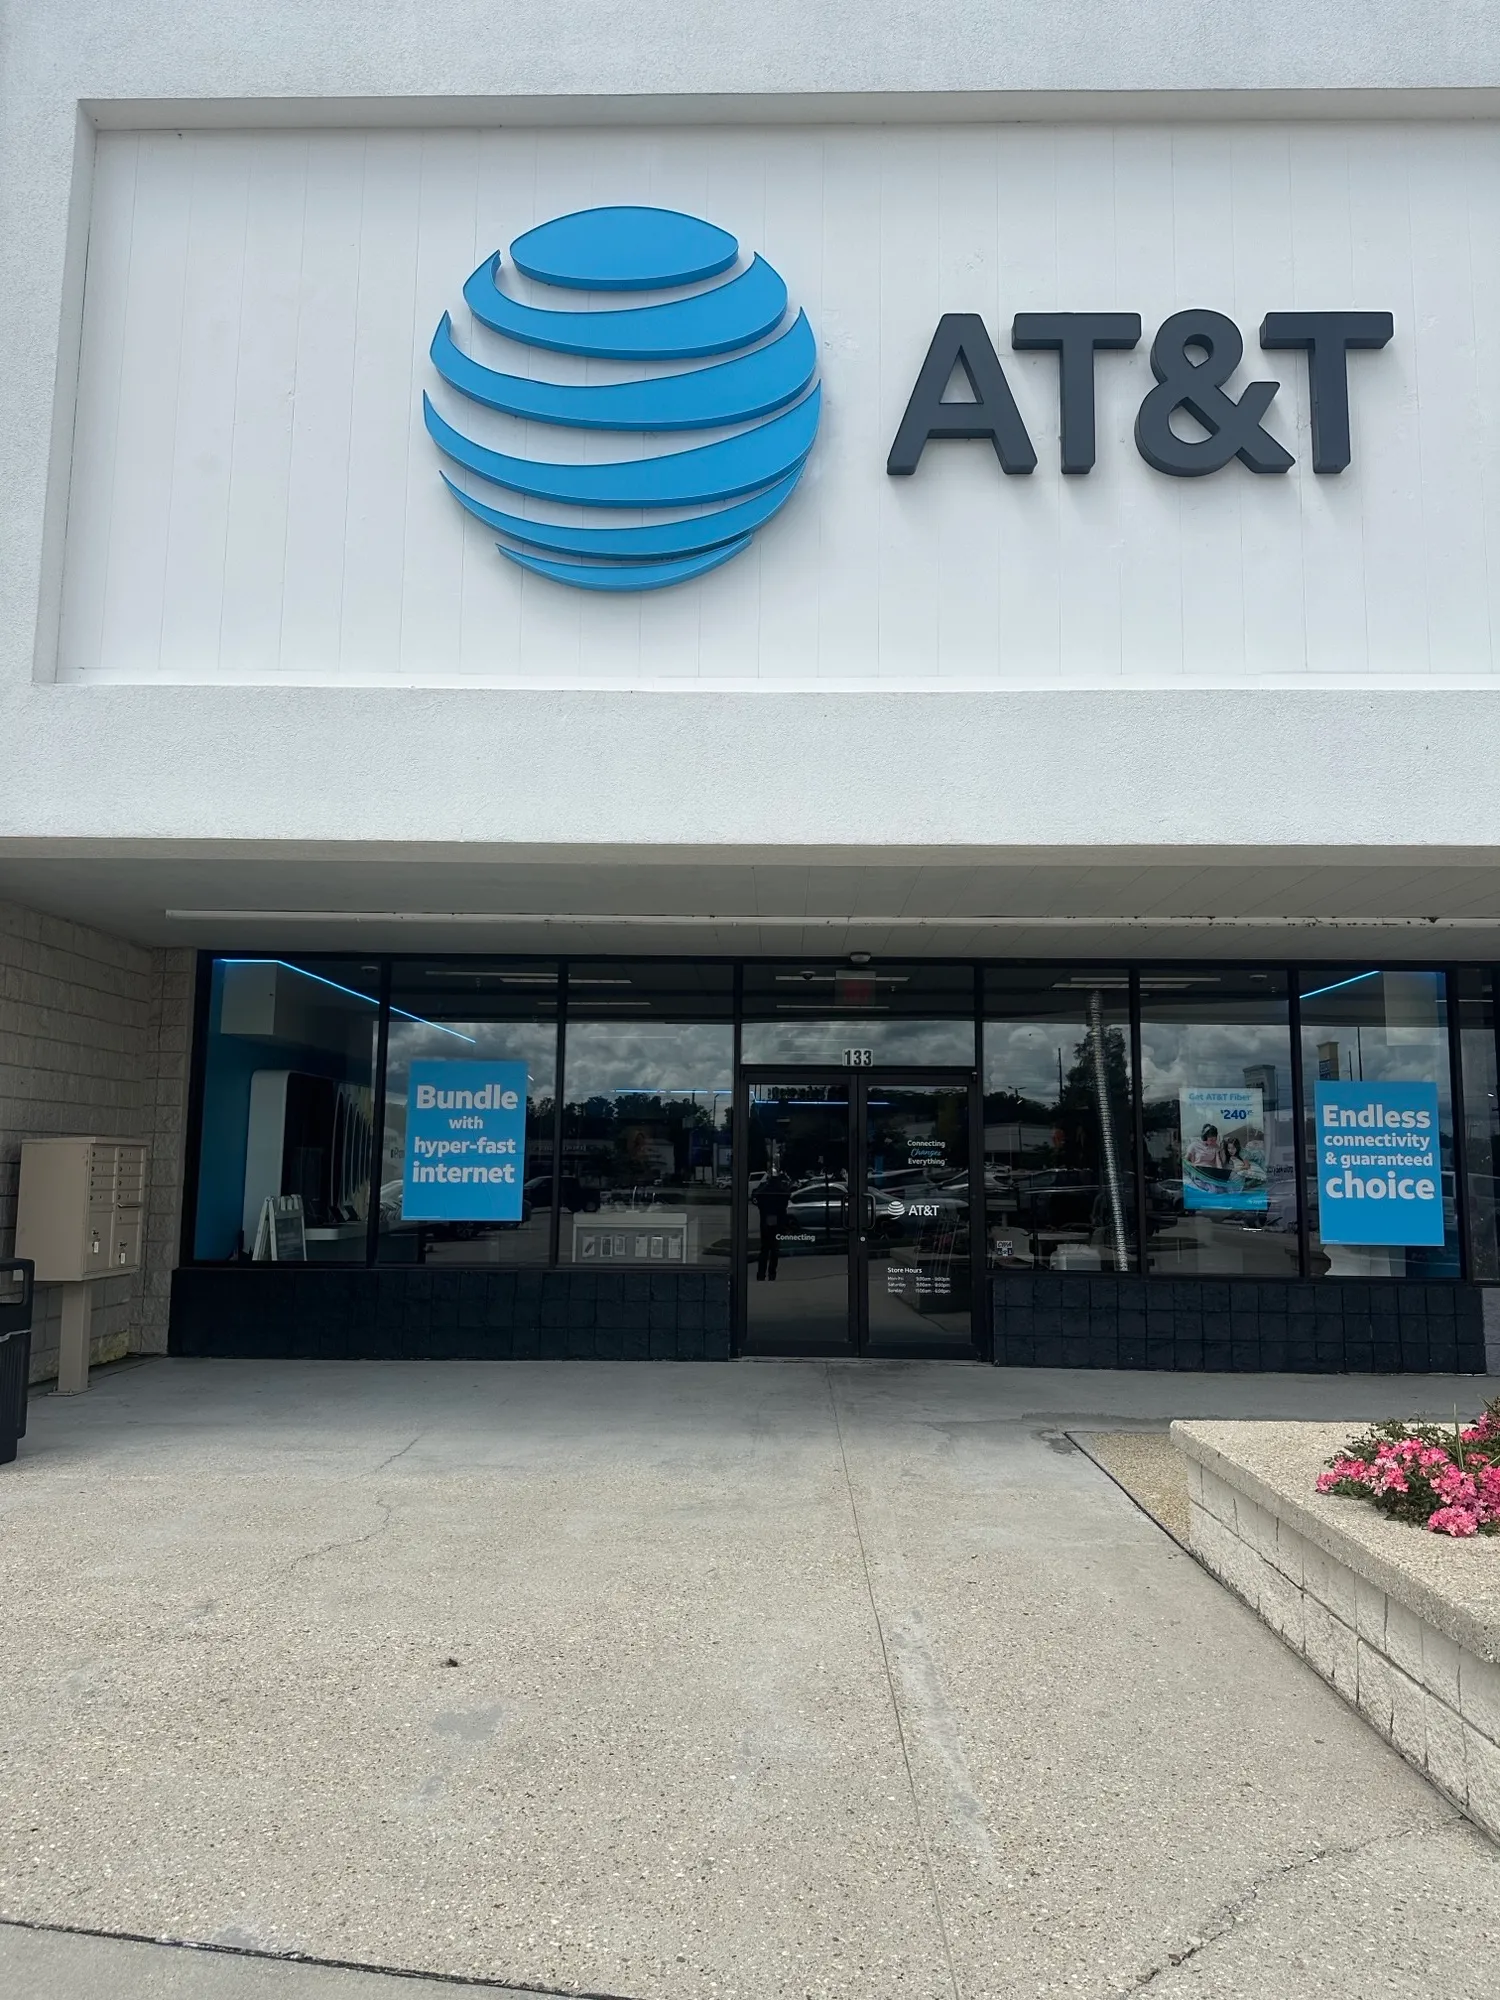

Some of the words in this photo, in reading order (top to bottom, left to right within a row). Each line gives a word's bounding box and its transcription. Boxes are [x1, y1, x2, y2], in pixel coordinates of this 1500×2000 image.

[887, 309, 1394, 477] AT&T
[844, 1050, 873, 1066] 133
[416, 1084, 518, 1109] Bundle
[1189, 1093, 1203, 1101] Get
[1206, 1093, 1228, 1101] AT&T
[1230, 1093, 1250, 1101] Fiber
[448, 1116, 484, 1129] with
[1322, 1104, 1431, 1129] Endless
[414, 1136, 516, 1158] hyper-fast
[907, 1140, 946, 1149] Connecting
[1323, 1133, 1431, 1151] connectivity
[1325, 1153, 1338, 1165] &
[1341, 1152, 1433, 1168] guaranteed
[412, 1160, 515, 1183] internet
[1325, 1170, 1435, 1200] choice
[908, 1205, 940, 1216] AT&T
[775, 1233, 816, 1243] Connecting
